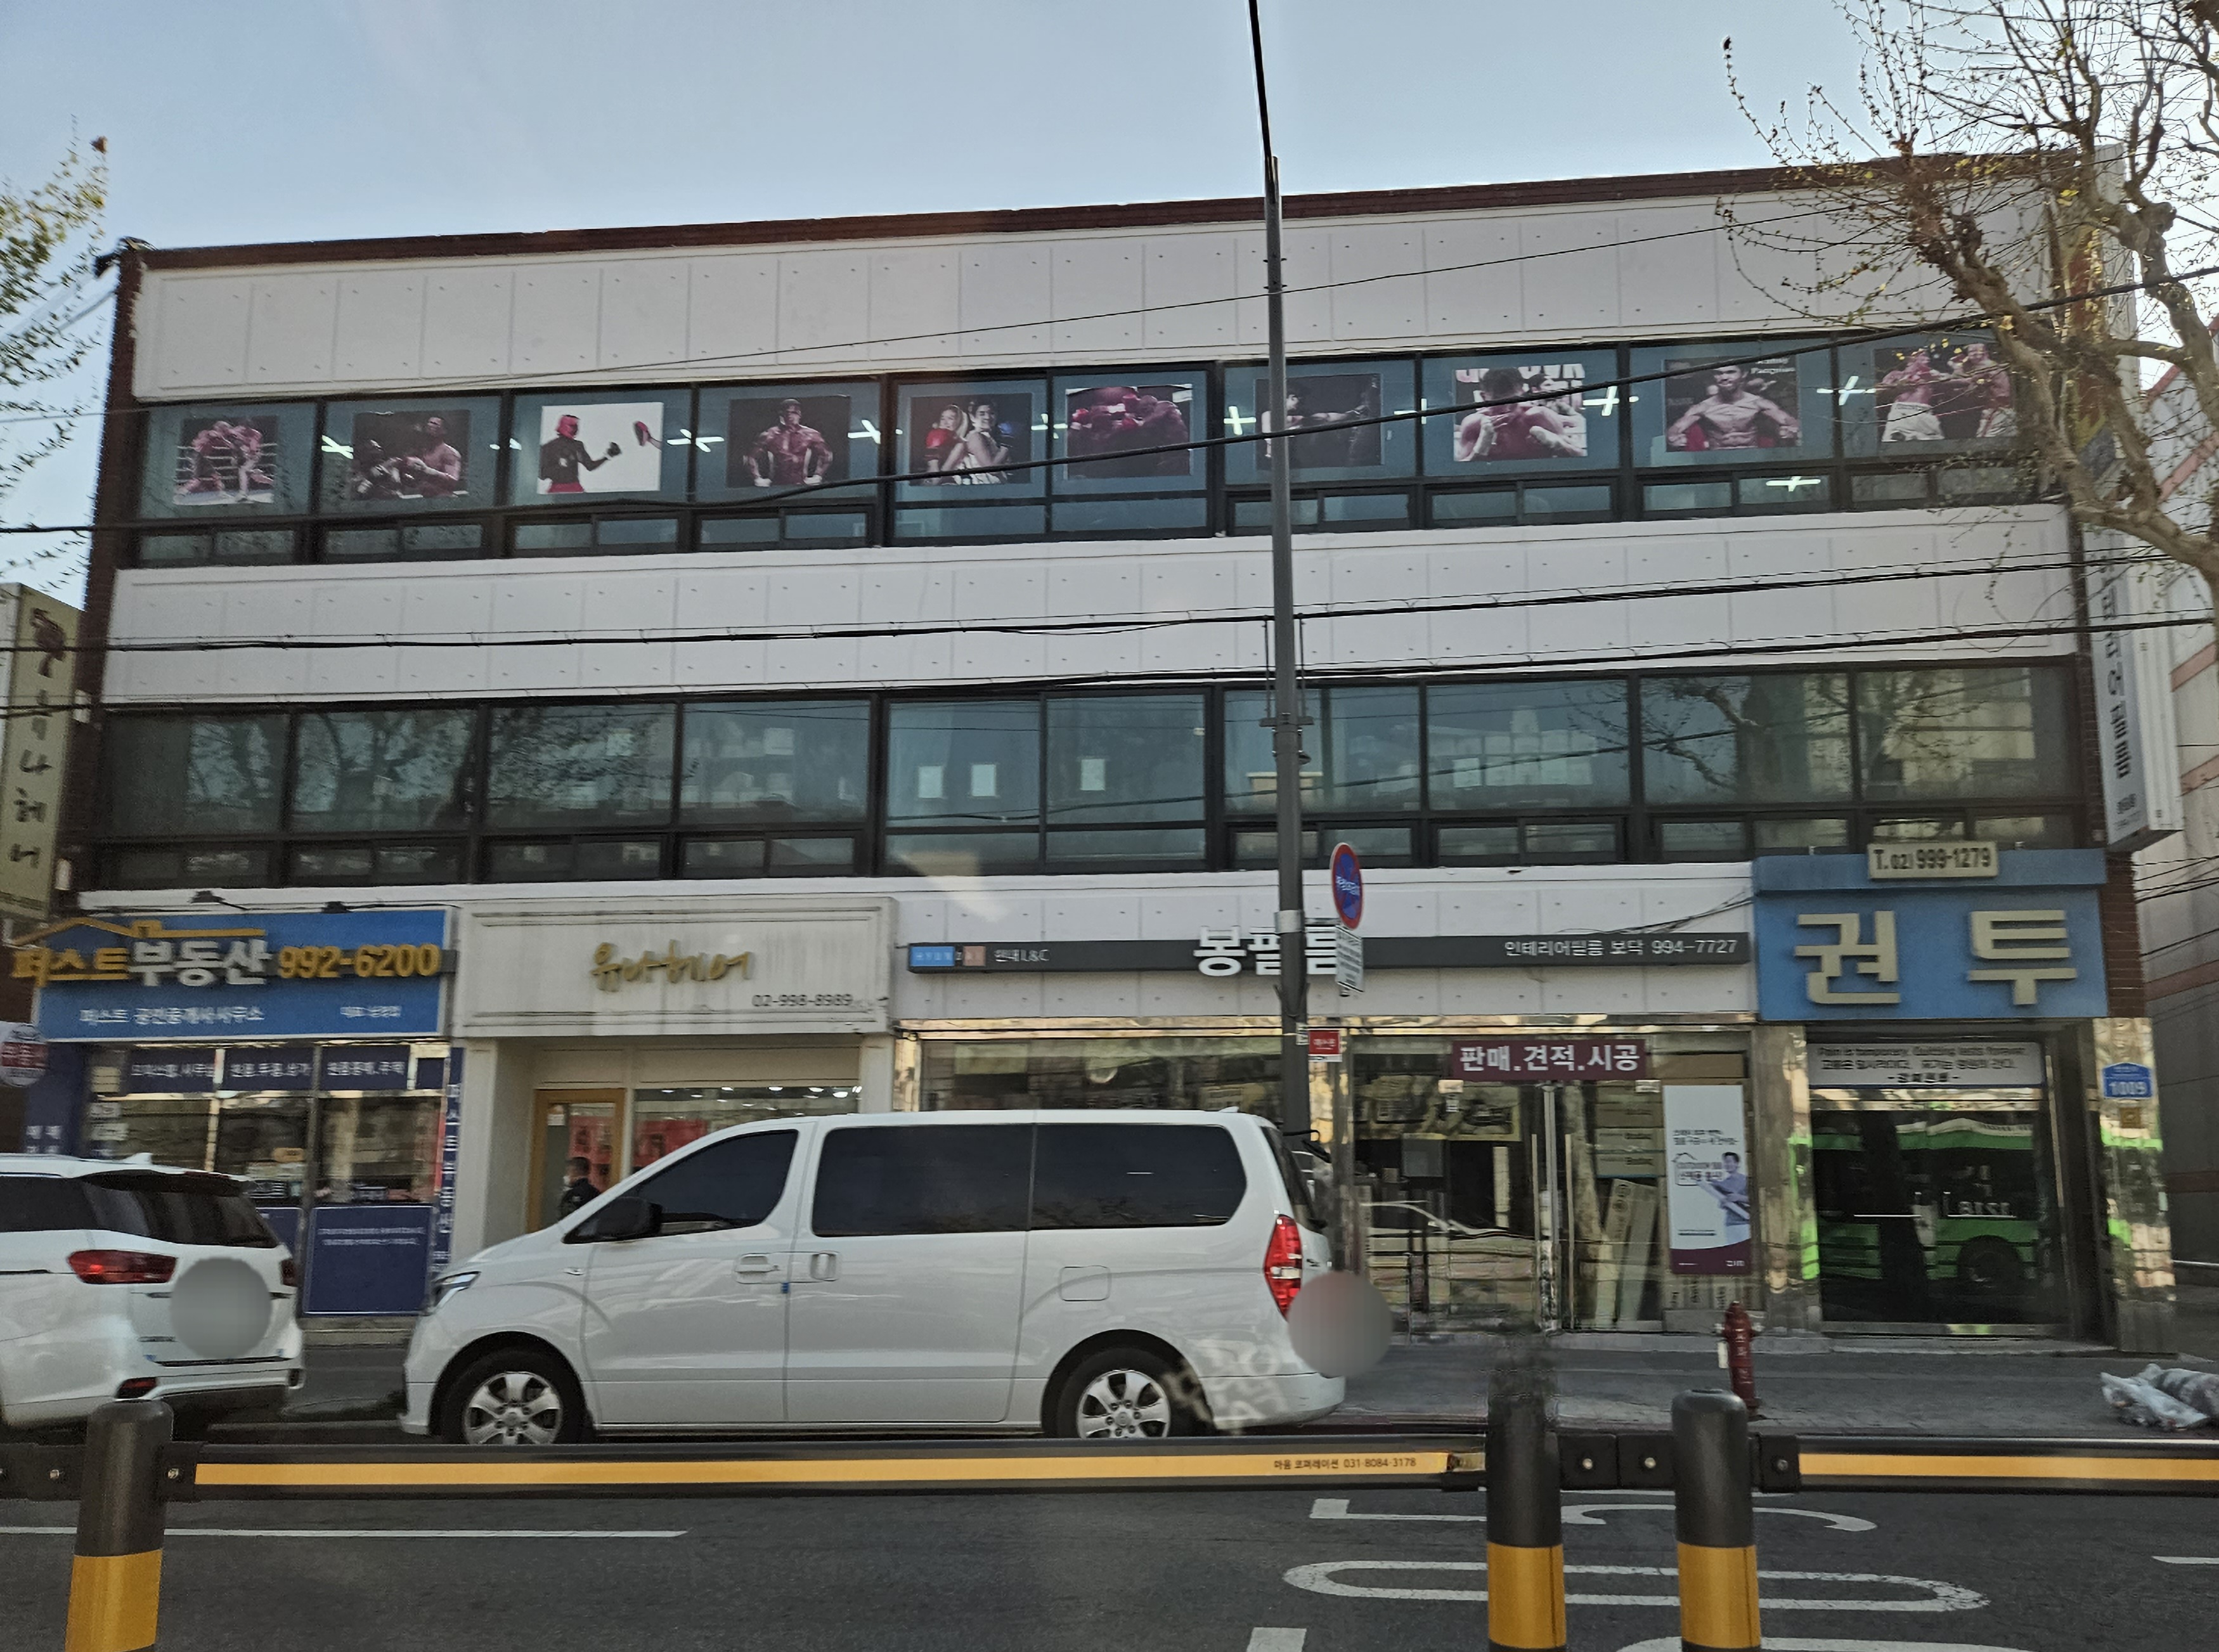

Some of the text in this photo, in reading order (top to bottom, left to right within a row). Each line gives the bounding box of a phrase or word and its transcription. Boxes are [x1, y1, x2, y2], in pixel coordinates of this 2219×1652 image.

[277, 942, 443, 979] 992-6200
[1504, 939, 1605, 957] 인테리어필름
[1651, 939, 1738, 955] 994-7727
[1794, 909, 2078, 1006] 권투
